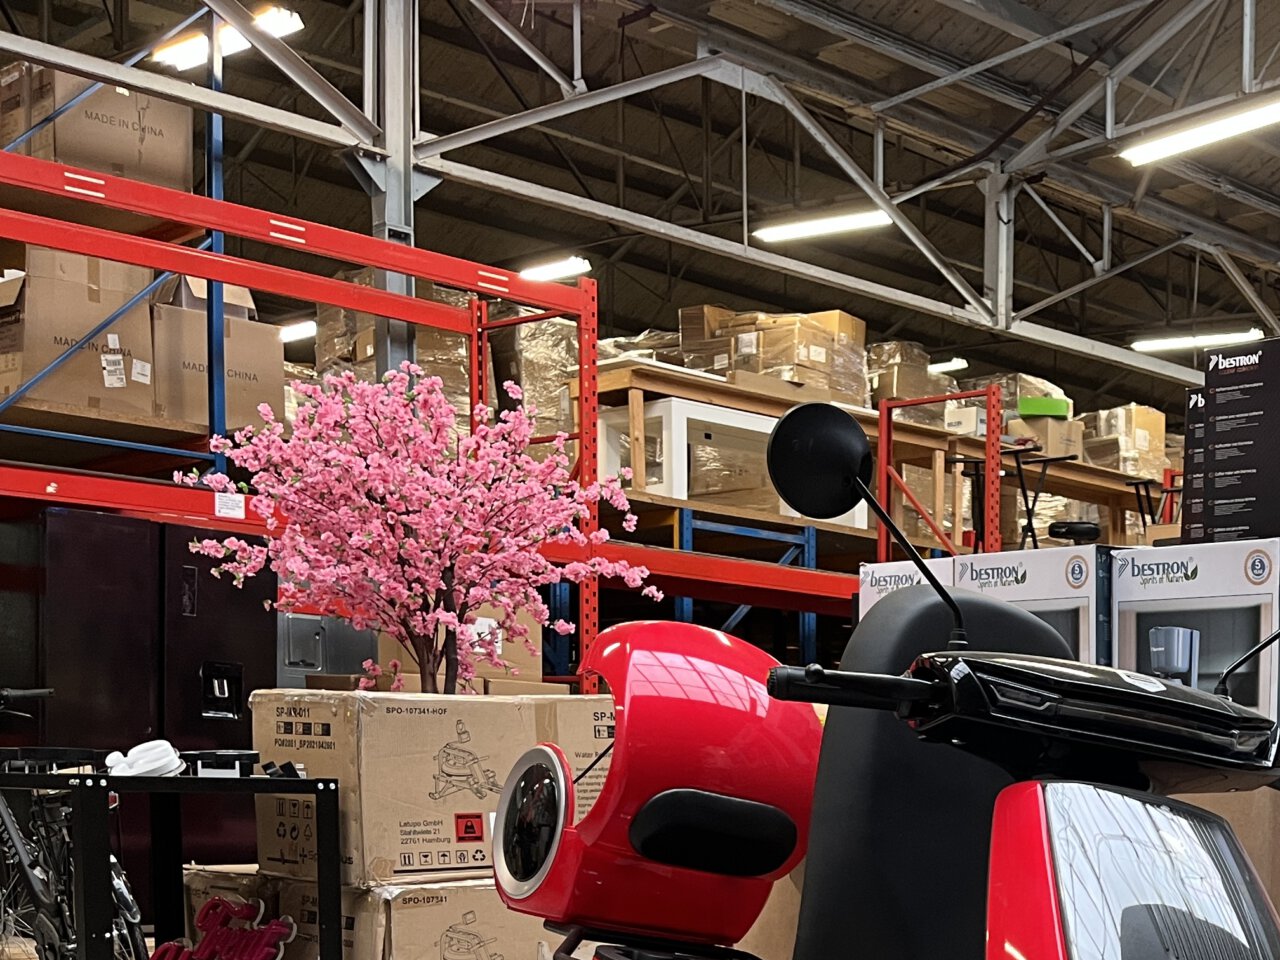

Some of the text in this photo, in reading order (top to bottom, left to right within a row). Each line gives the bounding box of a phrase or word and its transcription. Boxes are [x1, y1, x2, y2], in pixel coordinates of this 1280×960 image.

[84, 109, 165, 138] MADE IN CHINA
[53, 336, 84, 350] MAD
[226, 369, 259, 383] CHINA
[386, 707, 448, 715] SPO-107341-HOF
[422, 836, 451, 844] Hamburg
